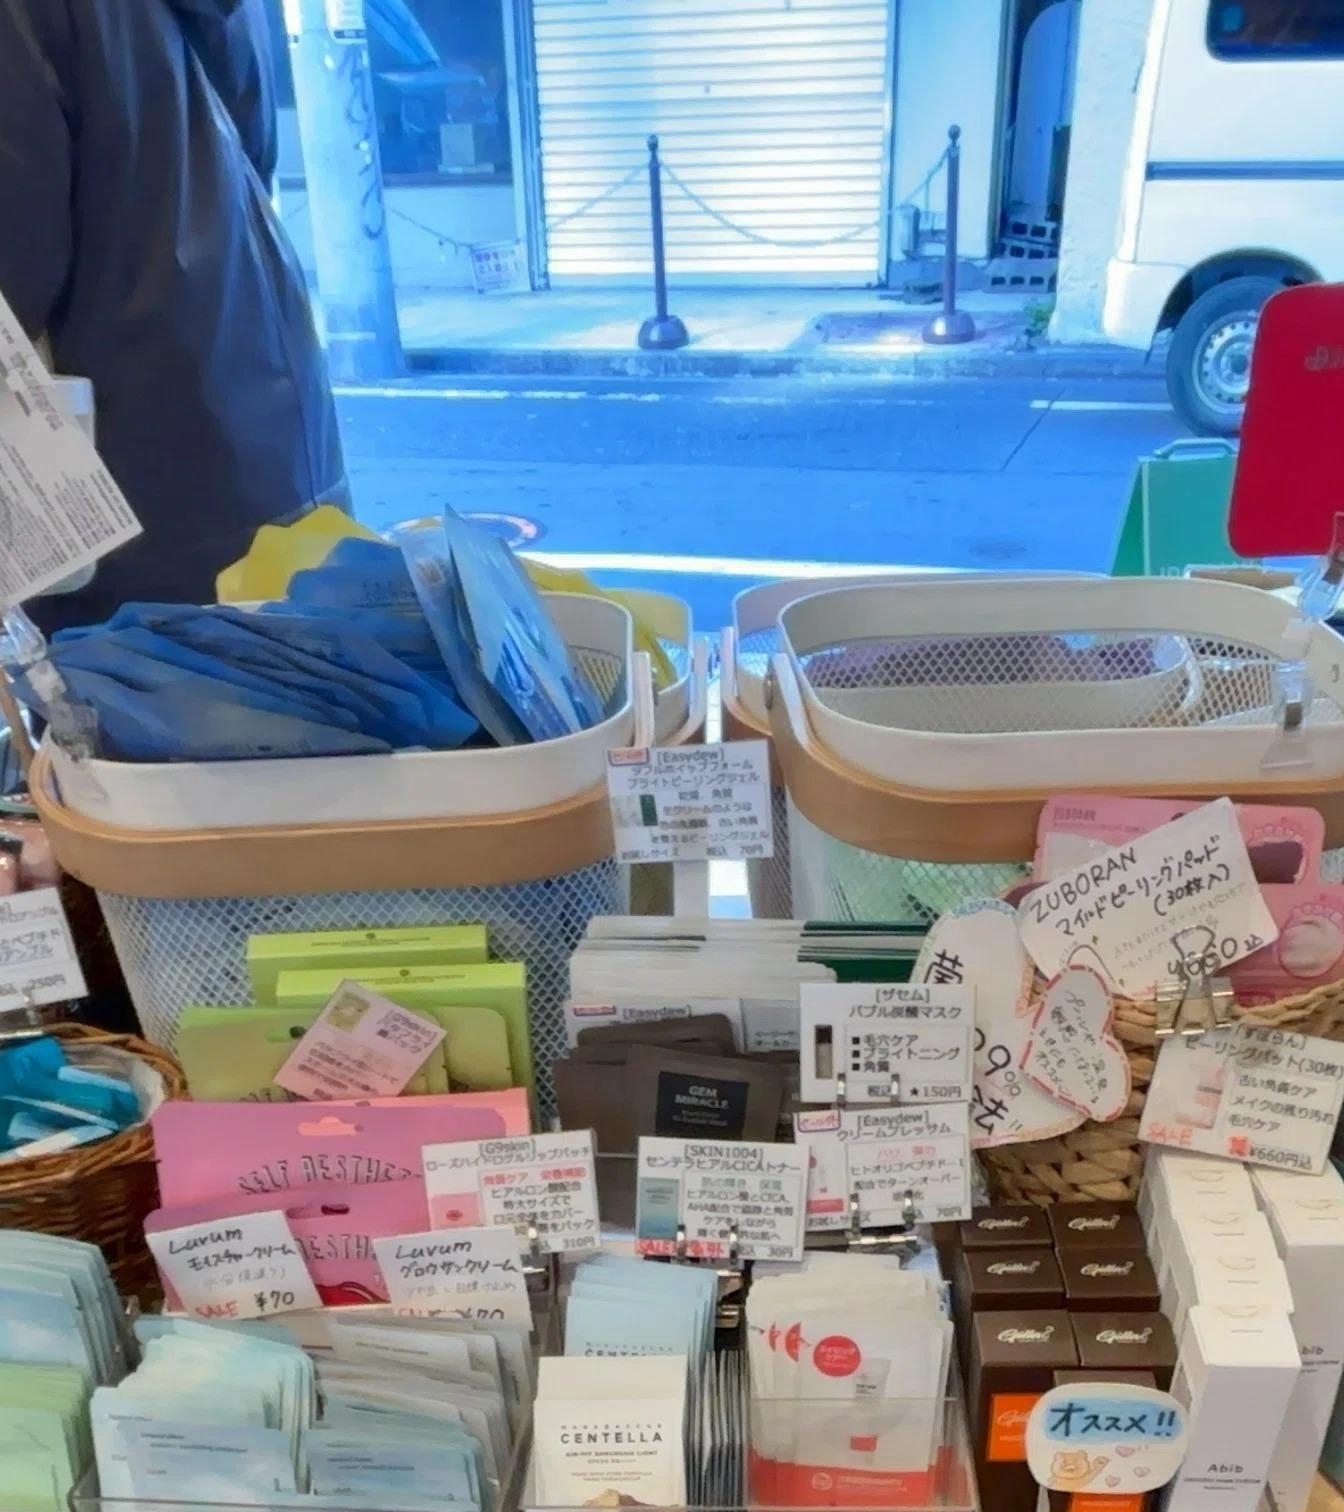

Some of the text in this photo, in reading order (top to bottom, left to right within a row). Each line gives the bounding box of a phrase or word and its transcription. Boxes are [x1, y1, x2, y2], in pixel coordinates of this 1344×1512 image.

[1029, 844, 1138, 926] ZUBORAN
[875, 988, 931, 1004] [ザセム]
[863, 1034, 919, 1047] 毛穴ケア
[684, 1143, 764, 1161] [SKIN1004]
[168, 1227, 244, 1256] Luvum
[394, 1240, 474, 1261] Luvum
[559, 1431, 664, 1445] CENTELLA
[1207, 1462, 1244, 1475] Abib
